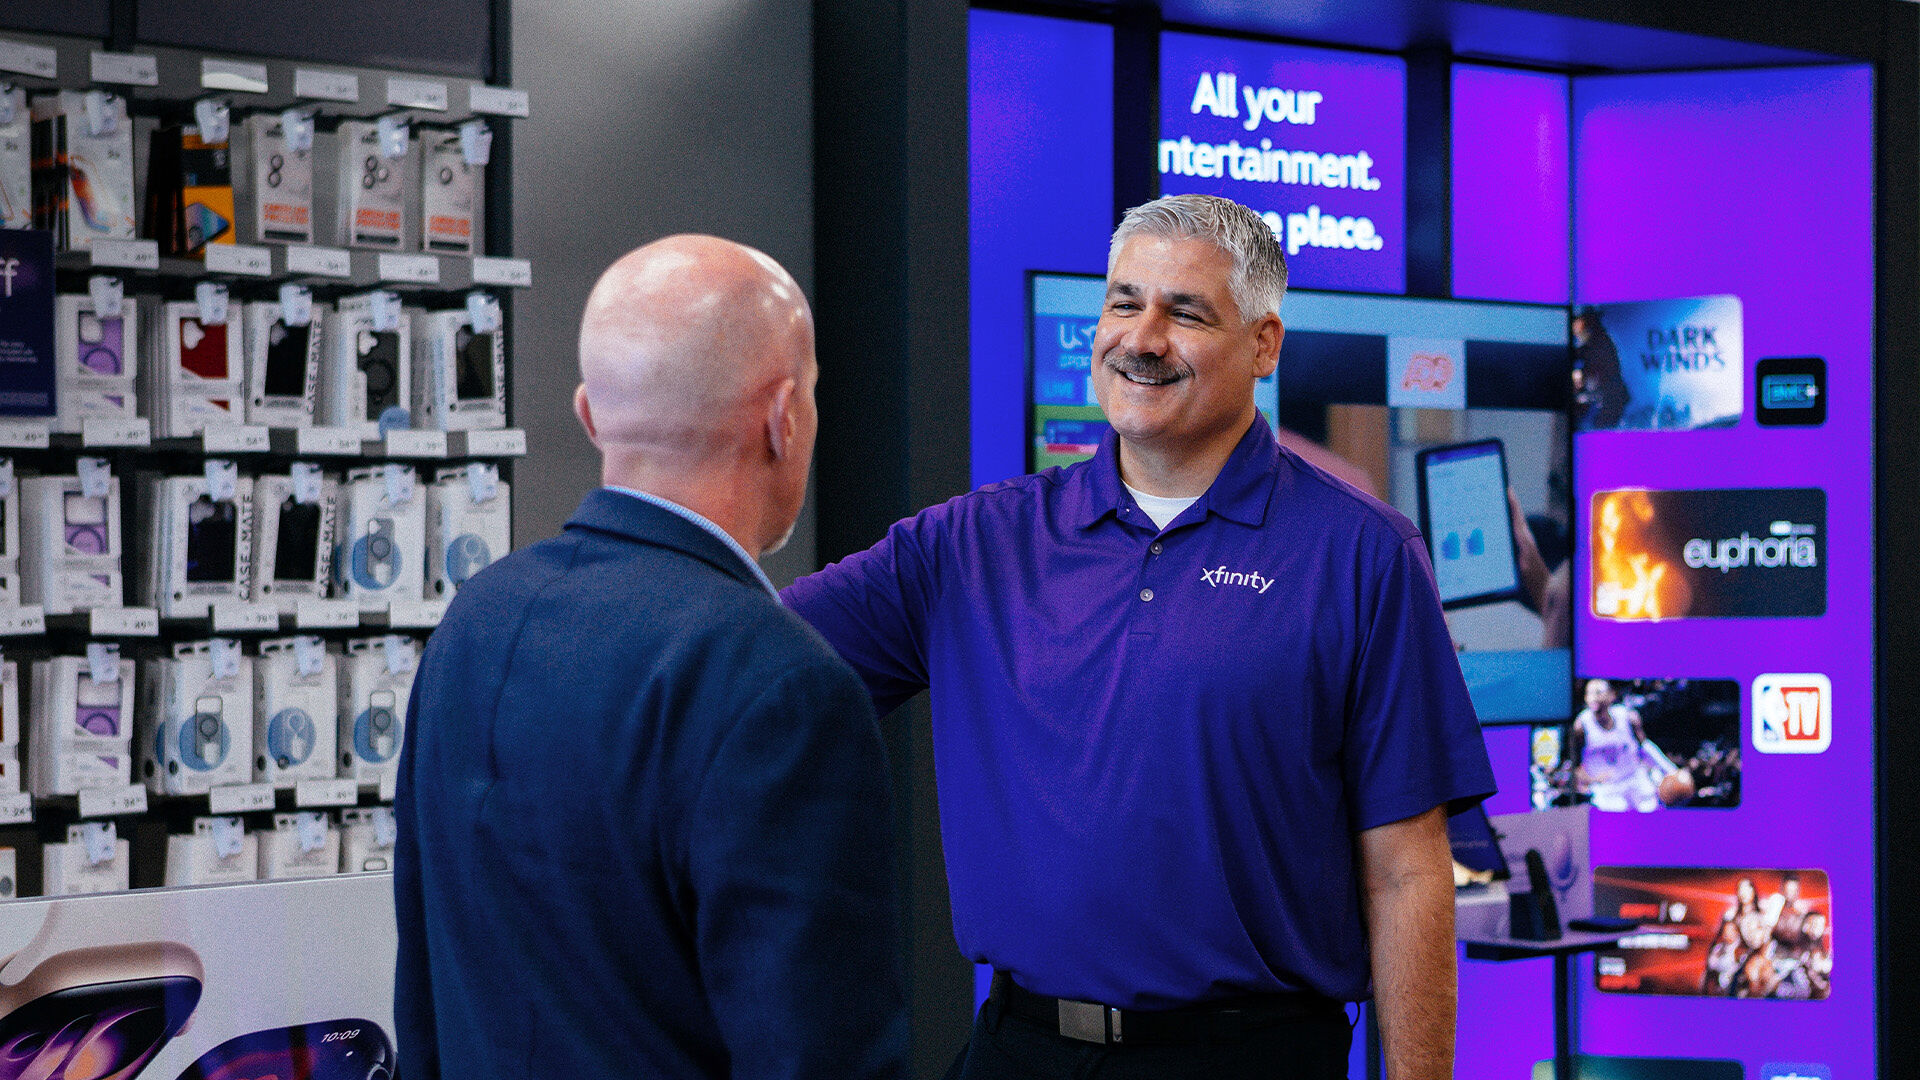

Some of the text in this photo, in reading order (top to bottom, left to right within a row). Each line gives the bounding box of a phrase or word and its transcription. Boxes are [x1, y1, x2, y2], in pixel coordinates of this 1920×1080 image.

[1191, 71, 1323, 131] All your
[1158, 135, 1381, 191] ntertainment.
[1286, 204, 1383, 256] place.
[1648, 326, 1718, 348] DARK
[1641, 352, 1726, 373] WINDS
[1683, 531, 1817, 573] euphoria
[1200, 566, 1275, 594] xfinity
[321, 1029, 360, 1043] 10:09
